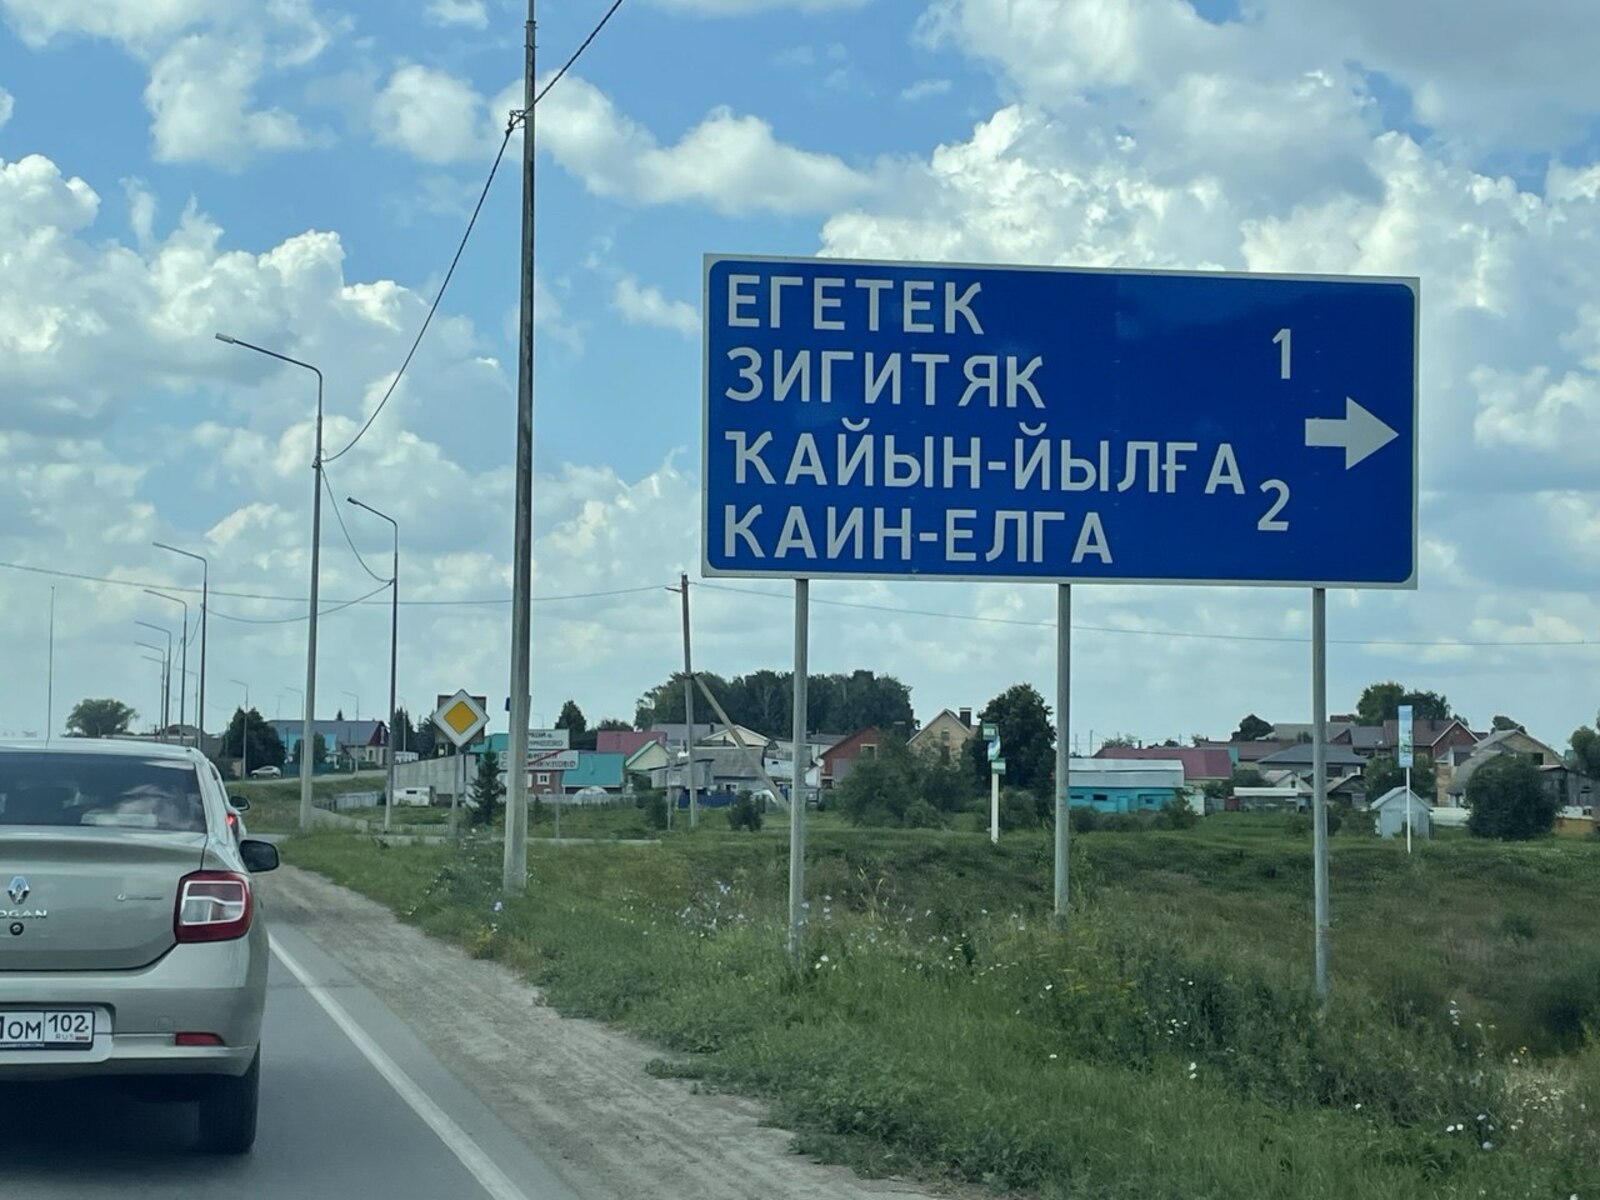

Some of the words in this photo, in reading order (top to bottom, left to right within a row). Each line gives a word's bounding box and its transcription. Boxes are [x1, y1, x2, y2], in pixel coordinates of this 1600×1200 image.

[726, 274, 984, 337] ЕГЕТЕК
[725, 347, 1046, 409] ЗИГИТЯК
[1272, 328, 1292, 380] 1
[724, 503, 1113, 565] КАИН-ЕЛГА
[1257, 479, 1291, 532] 2
[48, 1014, 86, 1033] 102
